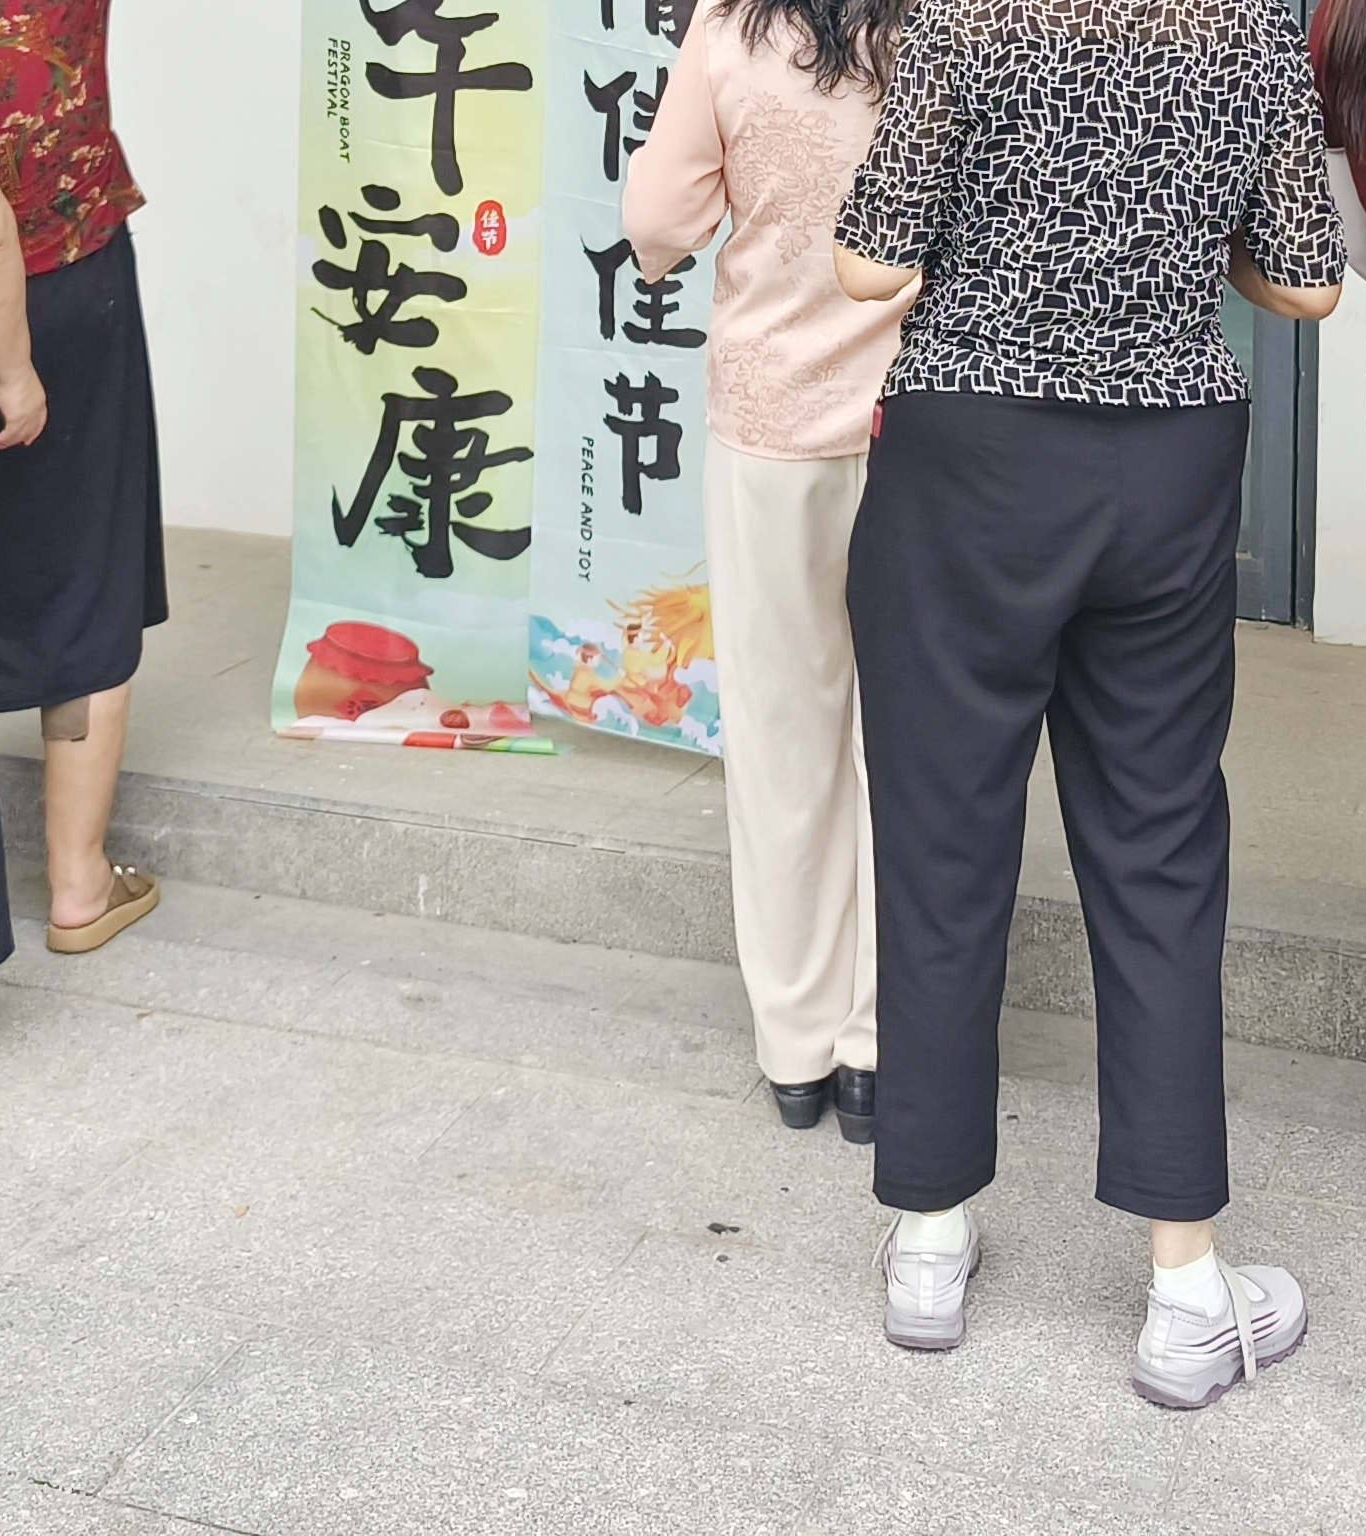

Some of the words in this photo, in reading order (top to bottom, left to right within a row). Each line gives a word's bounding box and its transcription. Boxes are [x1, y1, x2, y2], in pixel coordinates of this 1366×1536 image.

[327, 37, 339, 118] FESTIVAL
[339, 39, 352, 111] DRAGON
[338, 115, 351, 164] BOAT
[479, 210, 499, 249] 佳节
[580, 435, 595, 497] PEACE
[580, 501, 594, 542] AND
[577, 546, 593, 583] JOY
